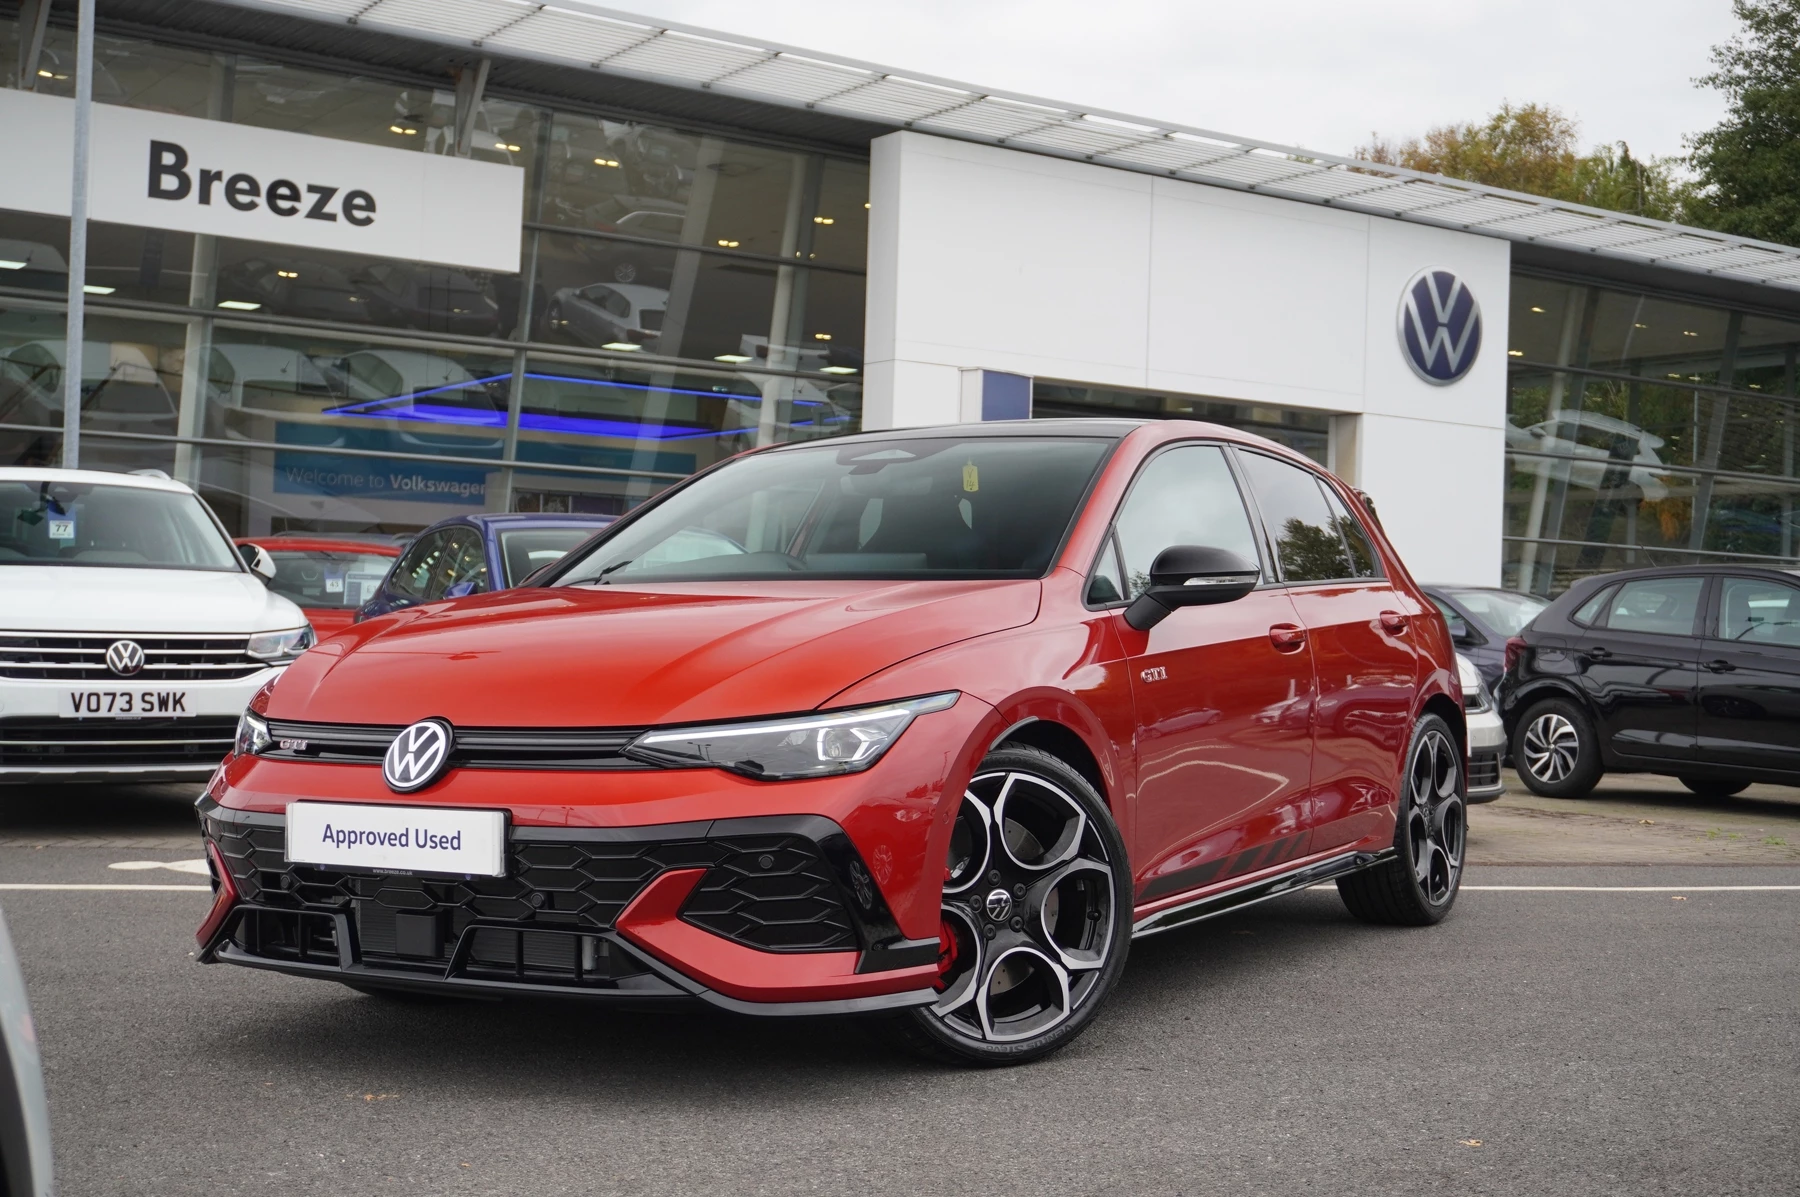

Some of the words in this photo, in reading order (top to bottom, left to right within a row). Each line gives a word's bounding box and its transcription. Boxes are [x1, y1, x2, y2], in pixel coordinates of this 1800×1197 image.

[147, 139, 377, 227] Breeze
[286, 466, 364, 488] Welcome
[369, 474, 385, 488] to
[55, 524, 69, 532] 77
[1140, 666, 1168, 683] GTI
[70, 691, 133, 713] VO73
[140, 691, 186, 713] SWK
[280, 738, 309, 750] GTI
[322, 823, 409, 849] Approved
[415, 828, 462, 851] Used
